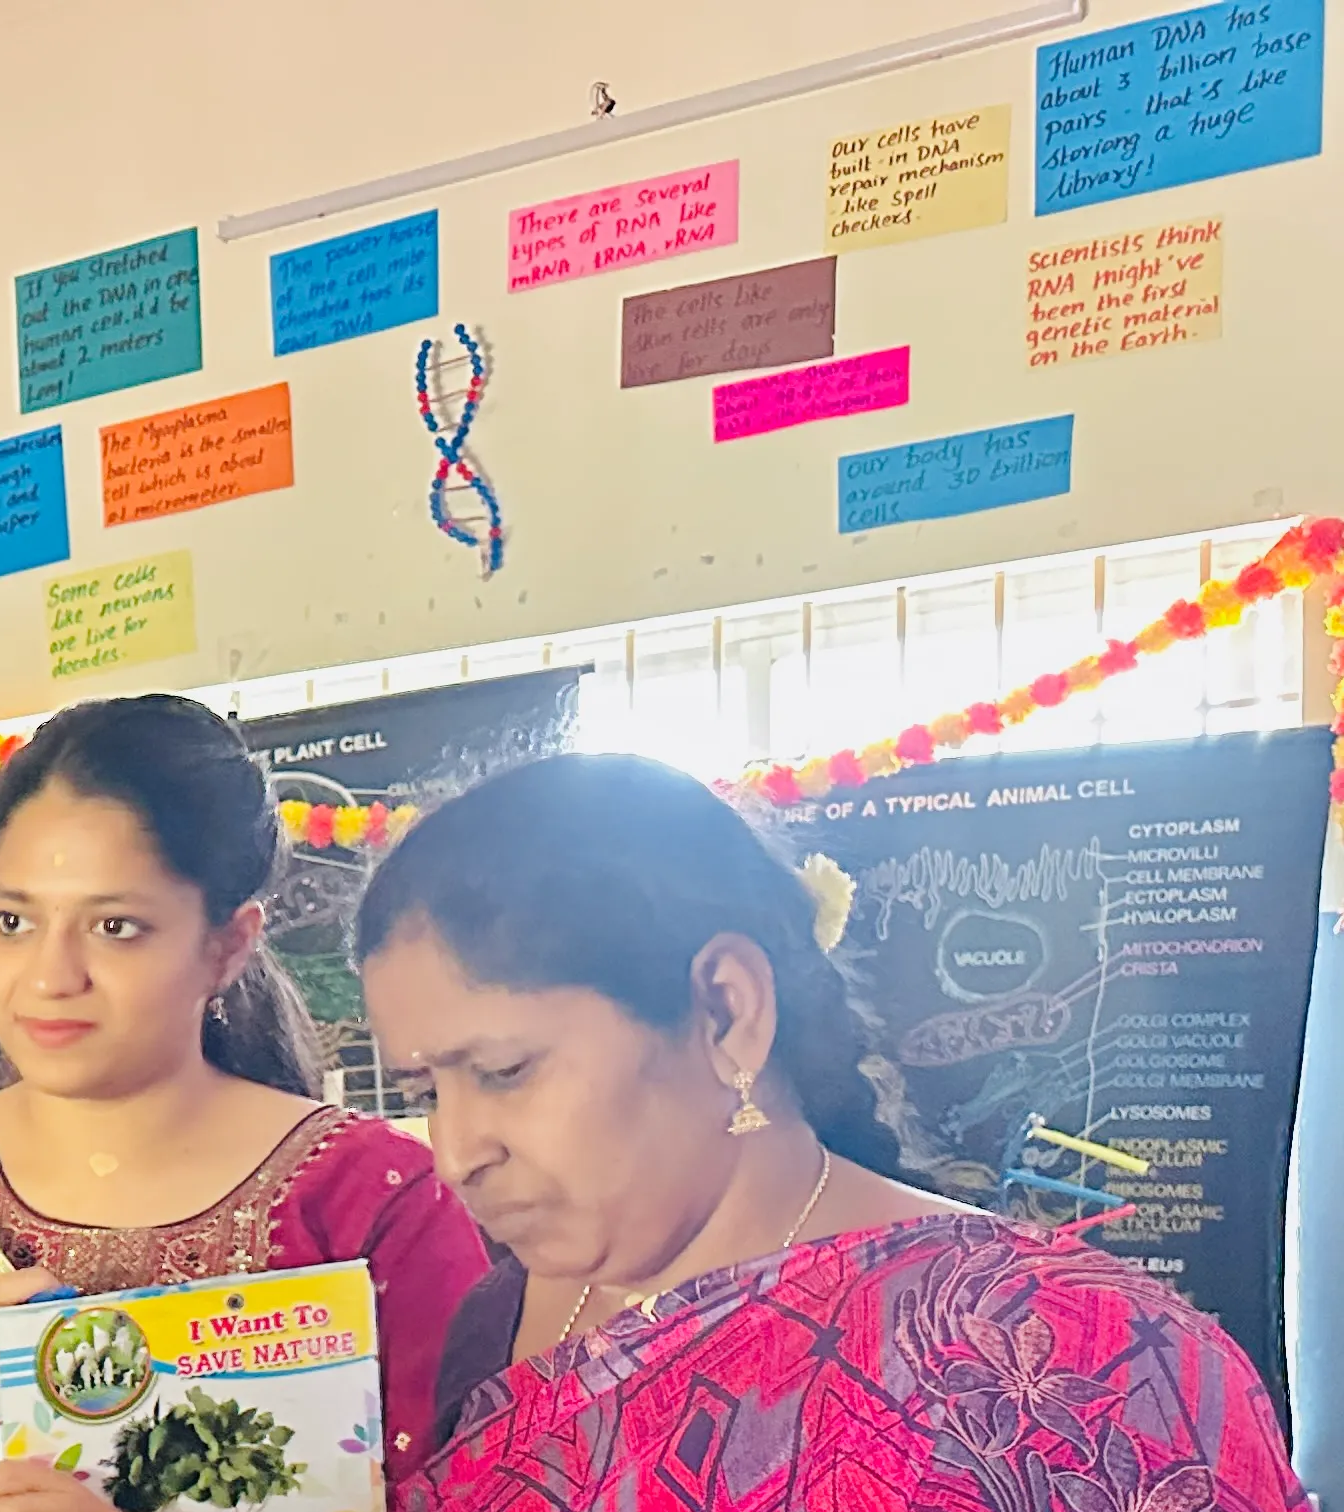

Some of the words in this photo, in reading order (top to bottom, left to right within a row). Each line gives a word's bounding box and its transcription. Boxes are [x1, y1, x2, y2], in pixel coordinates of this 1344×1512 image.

[1048, 41, 1134, 82] Human
[1151, 20, 1207, 52] DNA
[1225, 3, 1272, 32] has
[1041, 78, 1102, 111] about
[1117, 72, 1131, 91] 3
[1157, 46, 1237, 82] billion
[1252, 30, 1312, 58] base
[877, 124, 921, 149] cells
[931, 114, 981, 138] have
[1044, 109, 1107, 146] pairs
[1155, 125, 1175, 142] a
[1189, 102, 1256, 139] huge
[918, 139, 960, 162] DNA
[829, 175, 889, 197] repair
[899, 151, 1004, 183] mechanism
[517, 208, 579, 235] There
[588, 197, 622, 218] are
[511, 235, 566, 265] types
[579, 220, 600, 245] of
[616, 211, 661, 238] RNA
[1155, 220, 1223, 249] think
[98, 283, 137, 307] DNA
[144, 278, 160, 295] in
[1027, 272, 1075, 303] RNA
[1030, 300, 1085, 323] been
[1097, 292, 1135, 312] the
[1142, 279, 1188, 305] first
[1026, 316, 1112, 351] genetic
[1123, 295, 1219, 330] material
[1030, 350, 1058, 367] on
[1071, 340, 1109, 359] the
[905, 439, 963, 472] body
[984, 429, 1030, 456] has
[845, 470, 927, 504] around
[947, 467, 981, 490] 30
[846, 501, 900, 528] cells
[47, 579, 100, 609] Some
[274, 738, 335, 765] PLANT
[339, 731, 387, 754] CELL
[826, 802, 853, 820] OF
[862, 801, 877, 817] A
[885, 792, 976, 815] TYPICAL
[986, 784, 1072, 808] ANIMAL
[1078, 778, 1136, 798] CELL
[1128, 818, 1240, 839] CYTOPLASM
[1128, 845, 1219, 863] MICROVILLI
[1126, 869, 1164, 885] CELL
[1167, 865, 1264, 883] MEMBRANE
[1125, 886, 1227, 905] ECTOPLASM
[1124, 907, 1237, 926] HYALOPLASM
[954, 948, 1025, 968] VACUOLE
[1111, 1104, 1212, 1121] LYSOSOMES
[189, 1320, 200, 1341] I
[209, 1311, 285, 1337] Want
[293, 1304, 328, 1325] To
[177, 1349, 242, 1375] SAVE
[254, 1332, 353, 1364] NATURE
